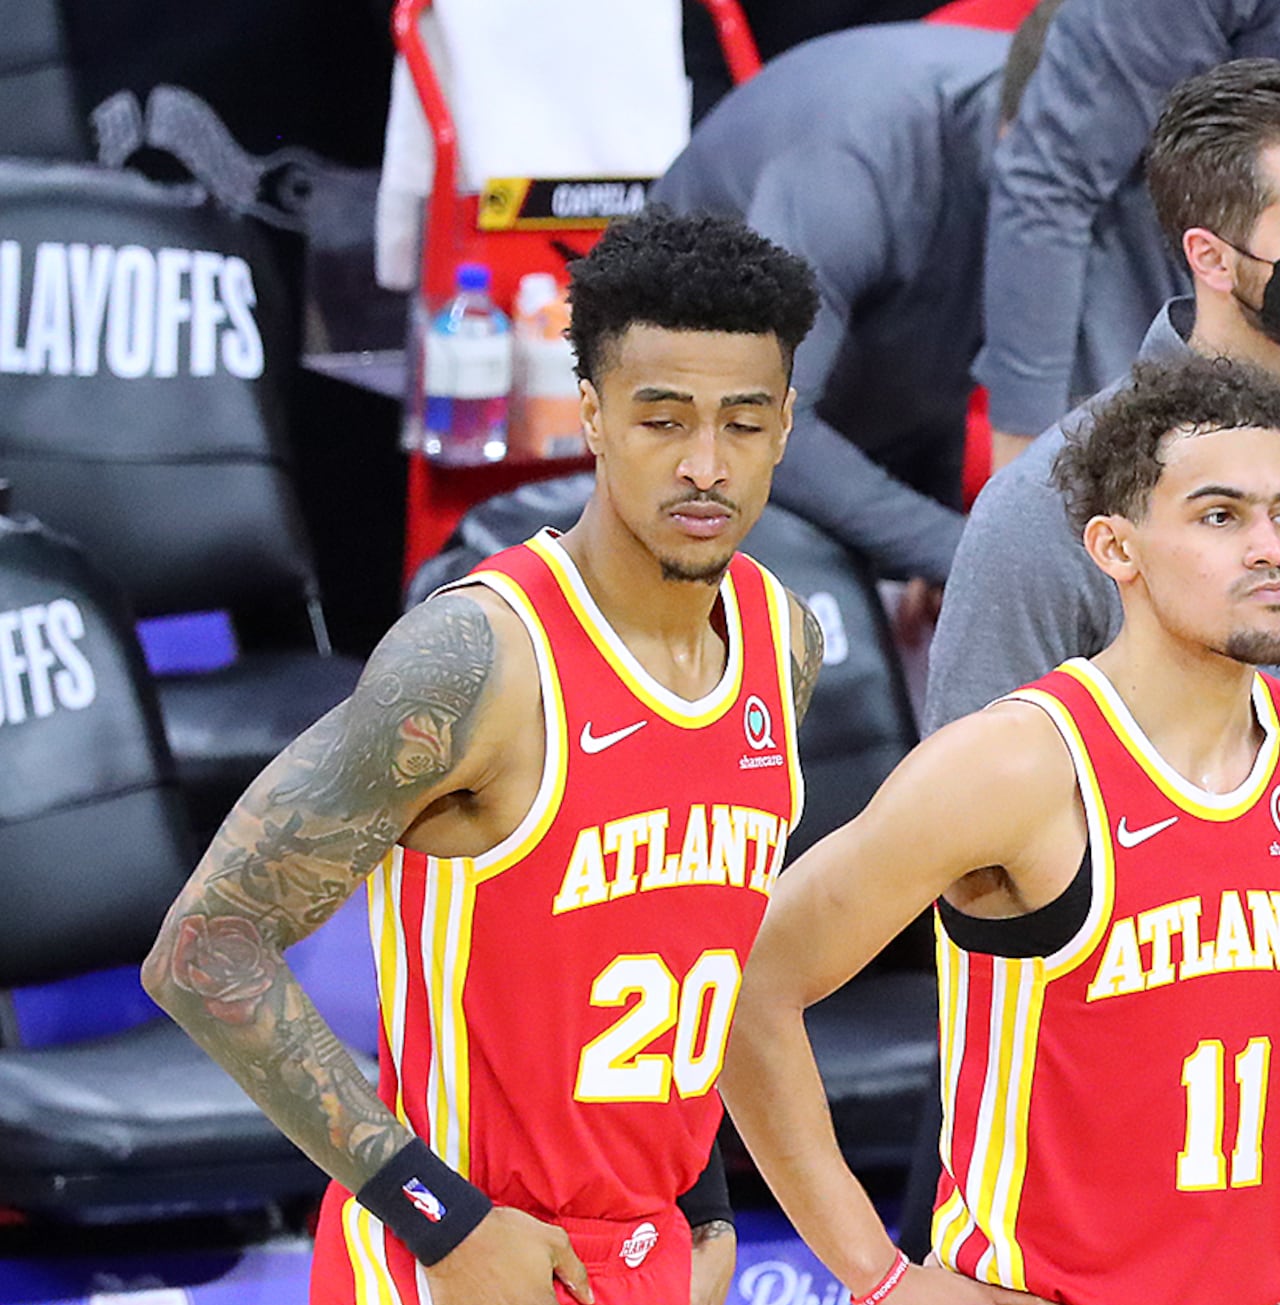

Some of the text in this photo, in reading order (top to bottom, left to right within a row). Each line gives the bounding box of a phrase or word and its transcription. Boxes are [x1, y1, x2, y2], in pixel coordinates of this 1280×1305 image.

[0, 239, 265, 379] LAYOFFS
[573, 948, 744, 1103] 20
[1176, 1036, 1273, 1191] 11
